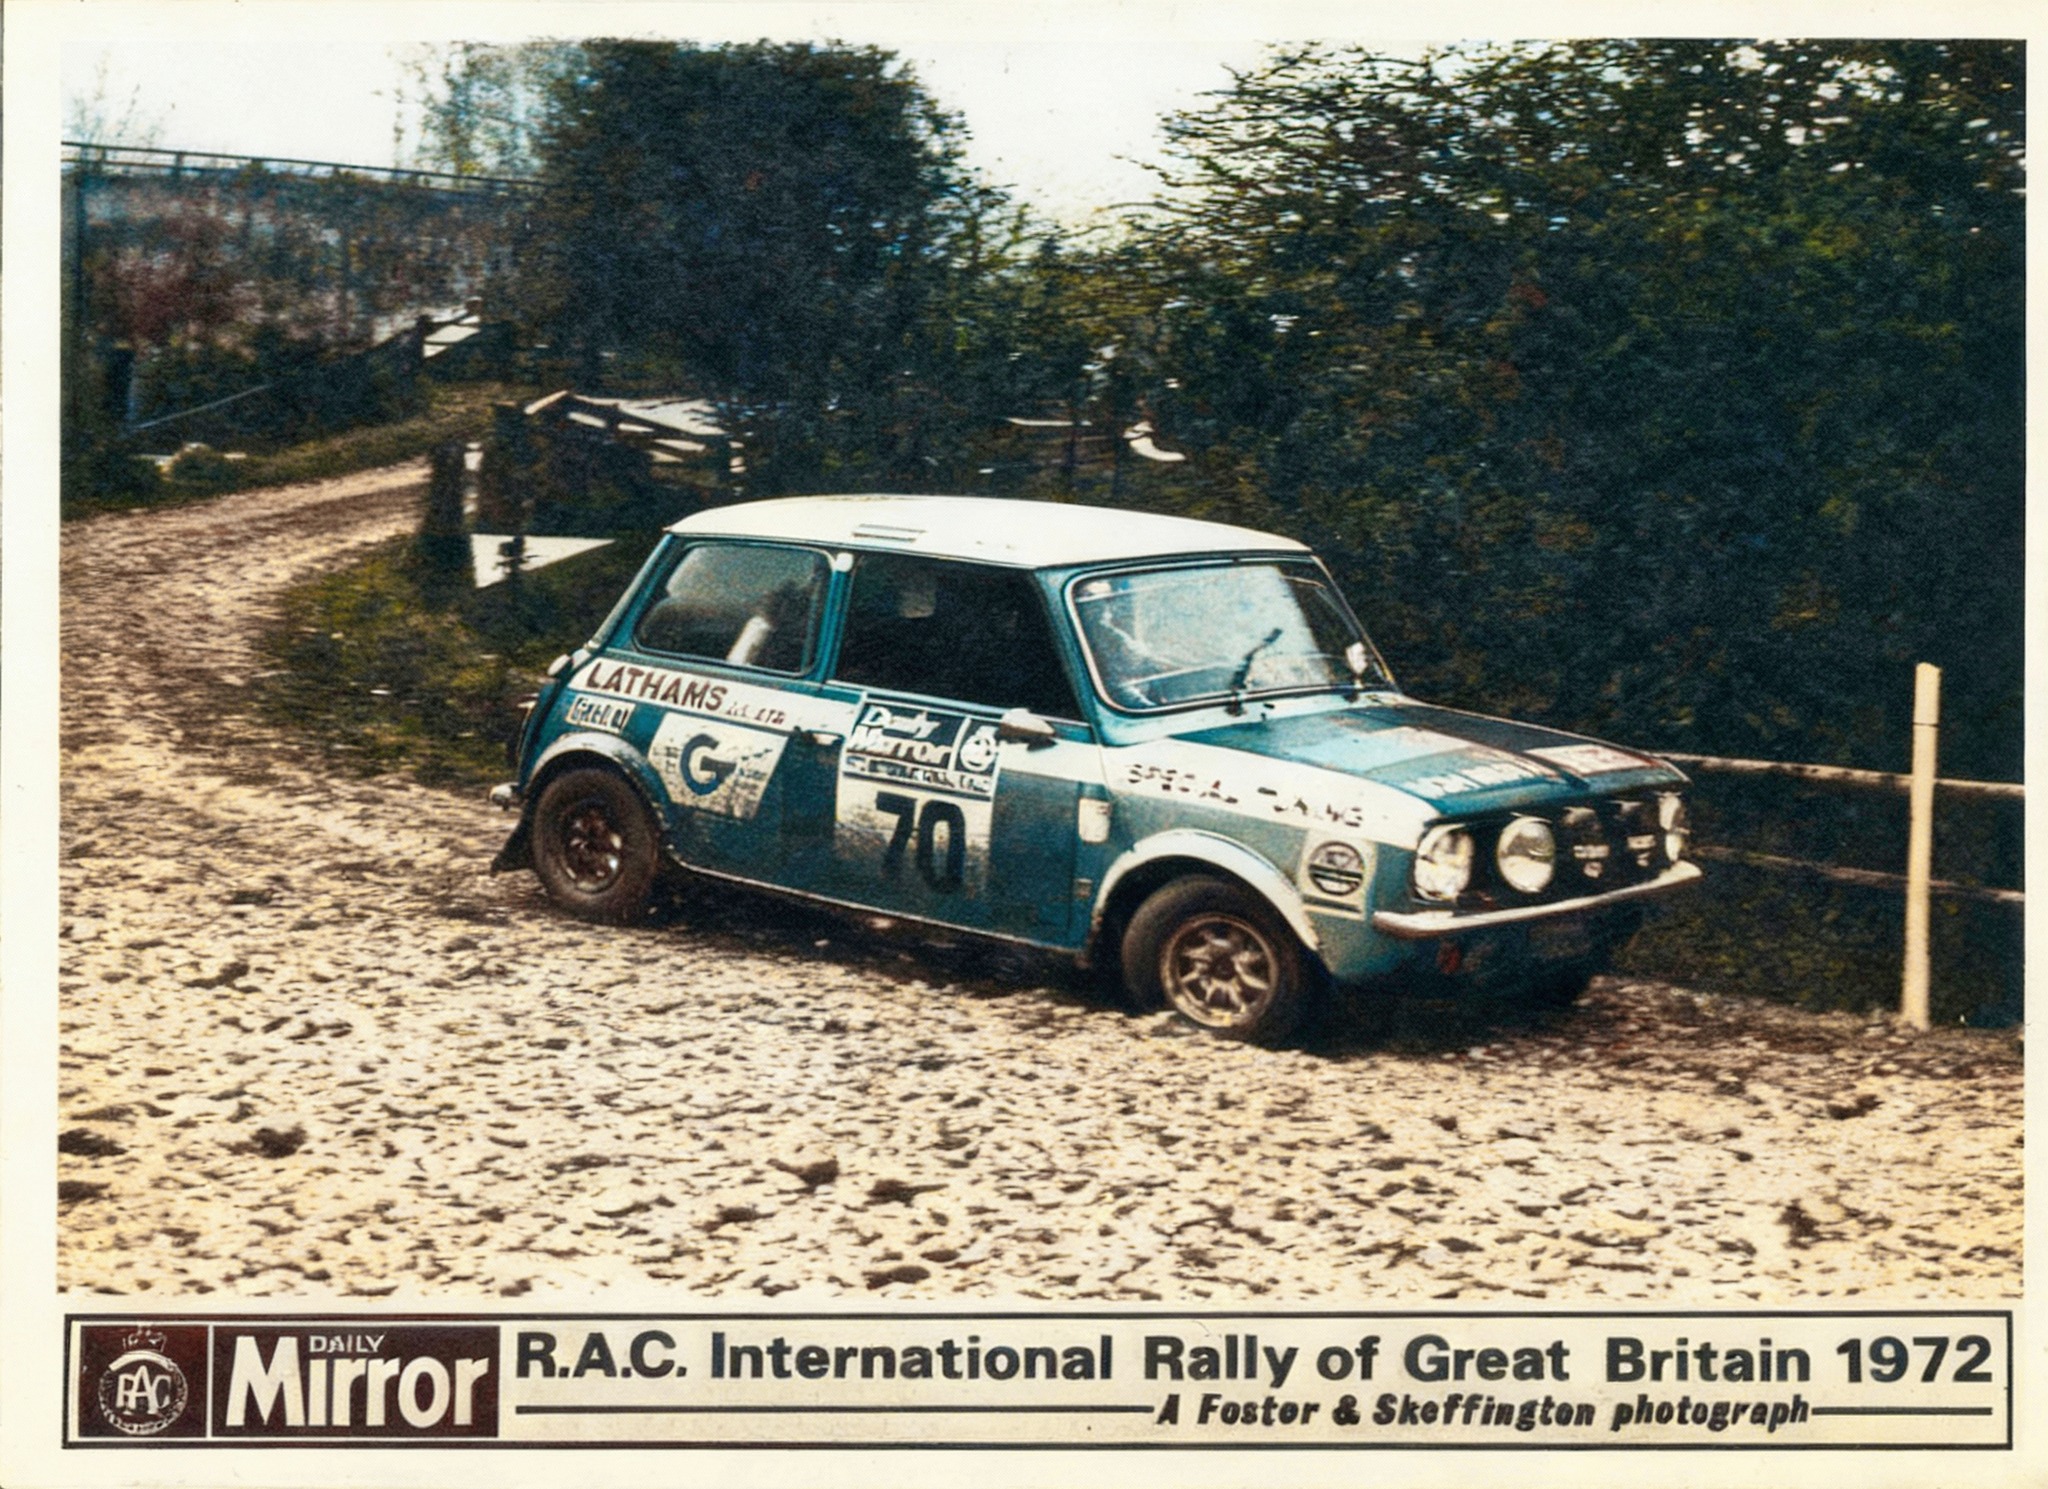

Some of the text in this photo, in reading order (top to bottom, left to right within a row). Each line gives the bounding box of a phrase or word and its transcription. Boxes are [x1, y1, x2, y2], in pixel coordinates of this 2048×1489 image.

[586, 663, 729, 711] LATHAMS
[679, 732, 737, 797] G
[875, 791, 967, 893] 70
